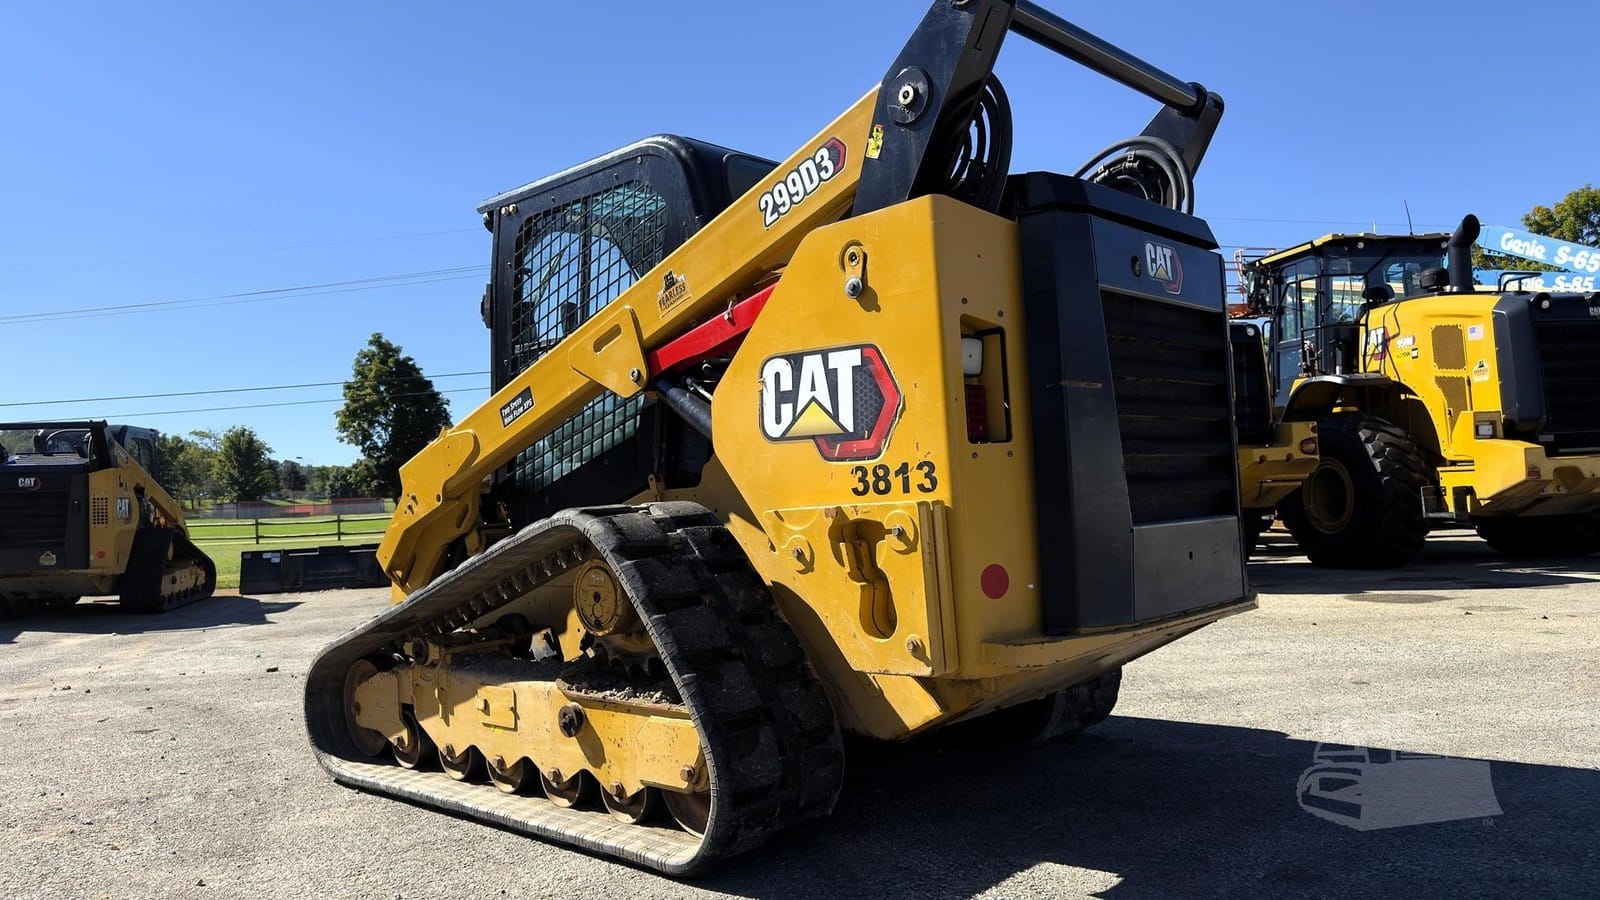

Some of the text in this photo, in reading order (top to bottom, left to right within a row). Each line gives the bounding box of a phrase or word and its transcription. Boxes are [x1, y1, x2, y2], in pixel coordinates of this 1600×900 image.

[759, 147, 835, 226] 299D3
[1145, 243, 1172, 280] CAT
[1500, 232, 1600, 272] Genie S-65
[658, 281, 687, 310] FEARLESS
[762, 348, 862, 438] CAT
[18, 477, 35, 488] CAT
[850, 460, 938, 496] 3813
[116, 498, 129, 519] CAT
